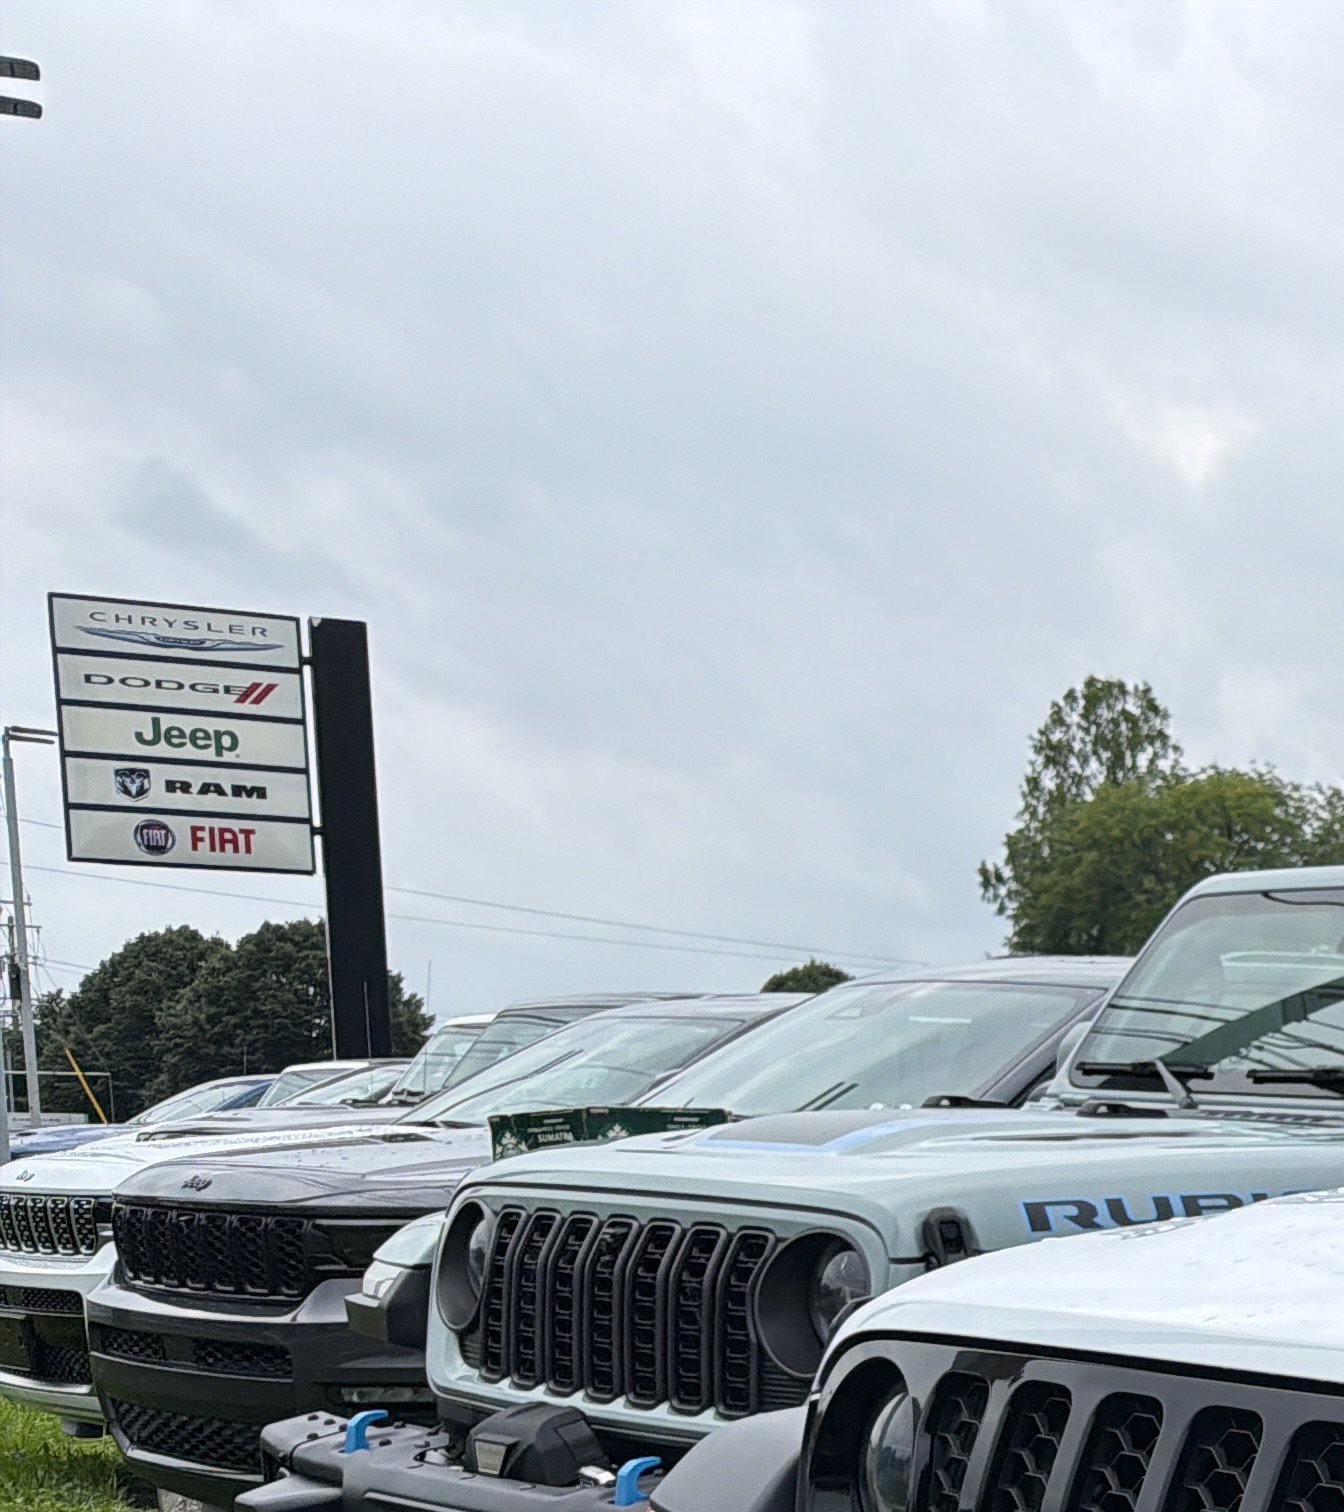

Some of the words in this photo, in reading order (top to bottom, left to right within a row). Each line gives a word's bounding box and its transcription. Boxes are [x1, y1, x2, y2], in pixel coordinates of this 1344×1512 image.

[89, 611, 268, 637] CHRYSLER
[83, 673, 250, 695] DODGE
[134, 717, 239, 757] Jeep
[164, 779, 268, 800] RAM
[142, 829, 167, 847] FIAT
[190, 825, 256, 855] FIAT
[537, 1131, 574, 1143] SUMATRA
